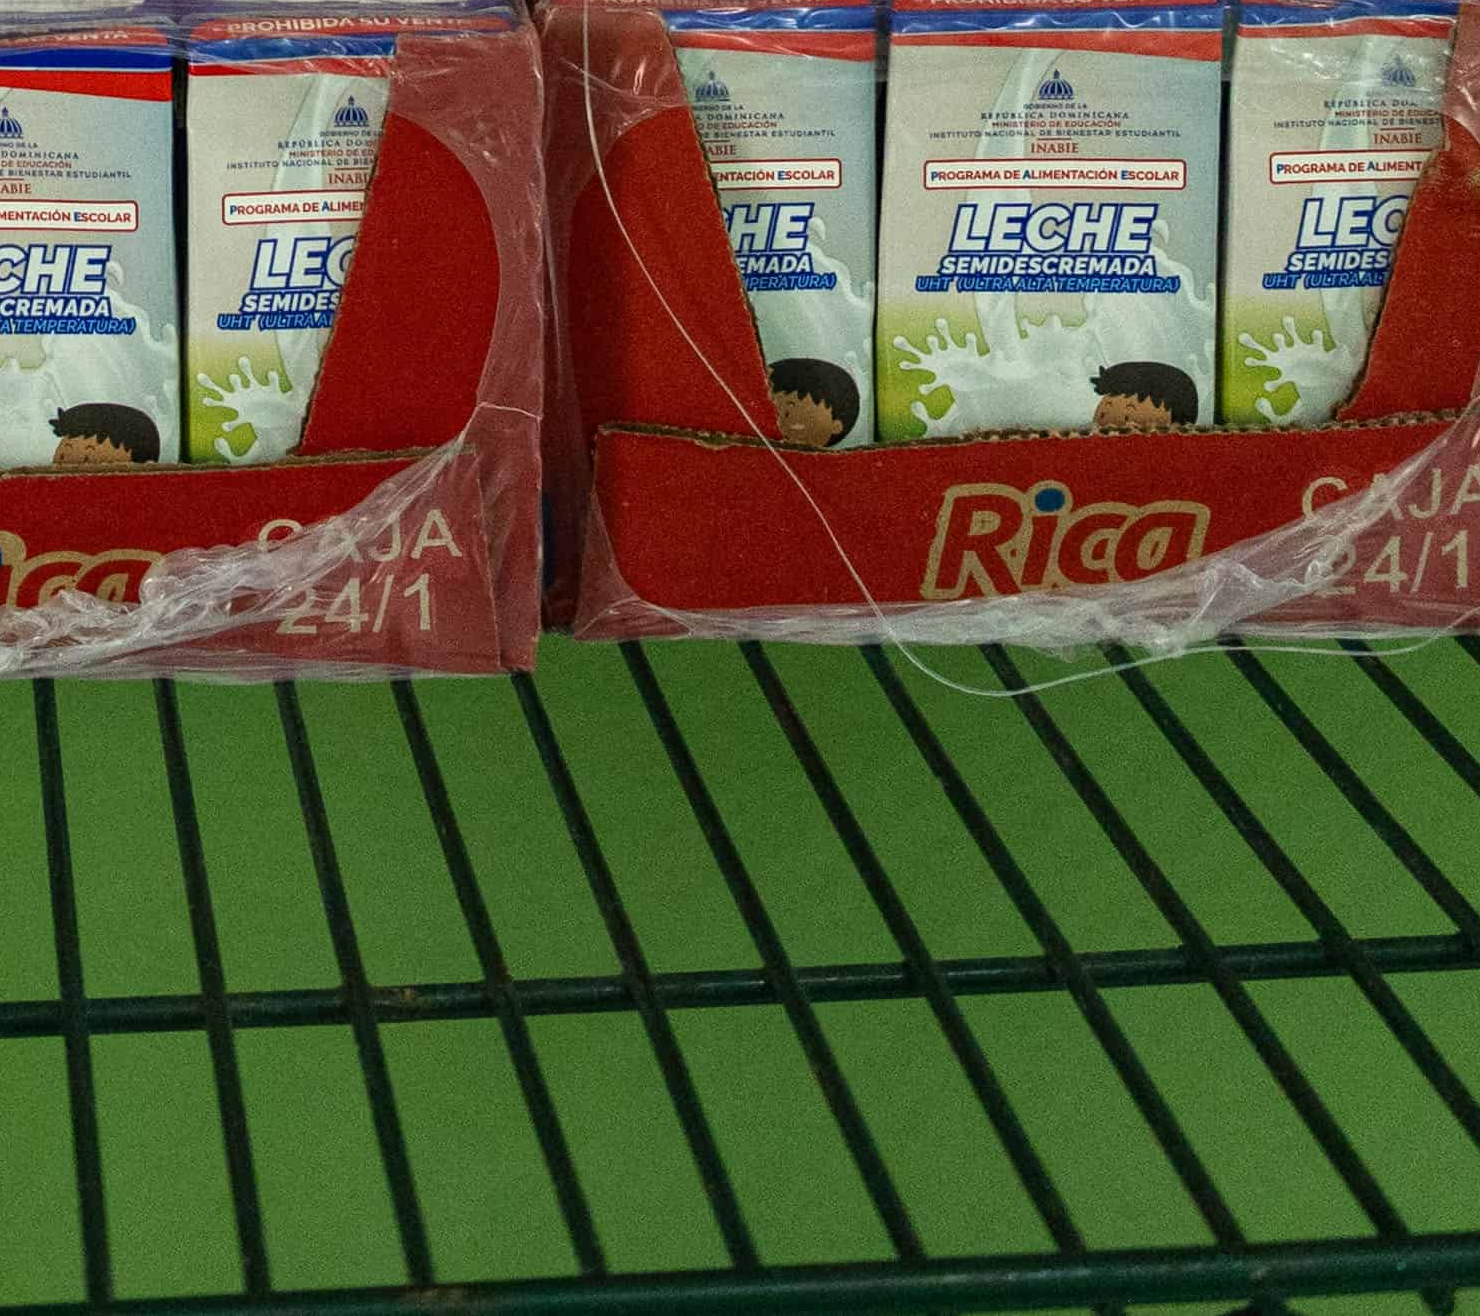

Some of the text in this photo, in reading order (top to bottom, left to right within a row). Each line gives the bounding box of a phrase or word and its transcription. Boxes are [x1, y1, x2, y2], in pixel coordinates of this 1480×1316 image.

[1030, 143, 1079, 153] INABIE
[930, 167, 1179, 182] PROGRAMA DE ALIMENTACIÓN ESCOLAR
[73, 212, 131, 223] ESCOLAR
[949, 204, 1157, 256] LECHE
[939, 253, 1156, 278] SEMIDESCREMADA
[15, 316, 136, 335] TEMPERATURA)
[921, 483, 1211, 602] Rica
[277, 571, 433, 633] 24/1
